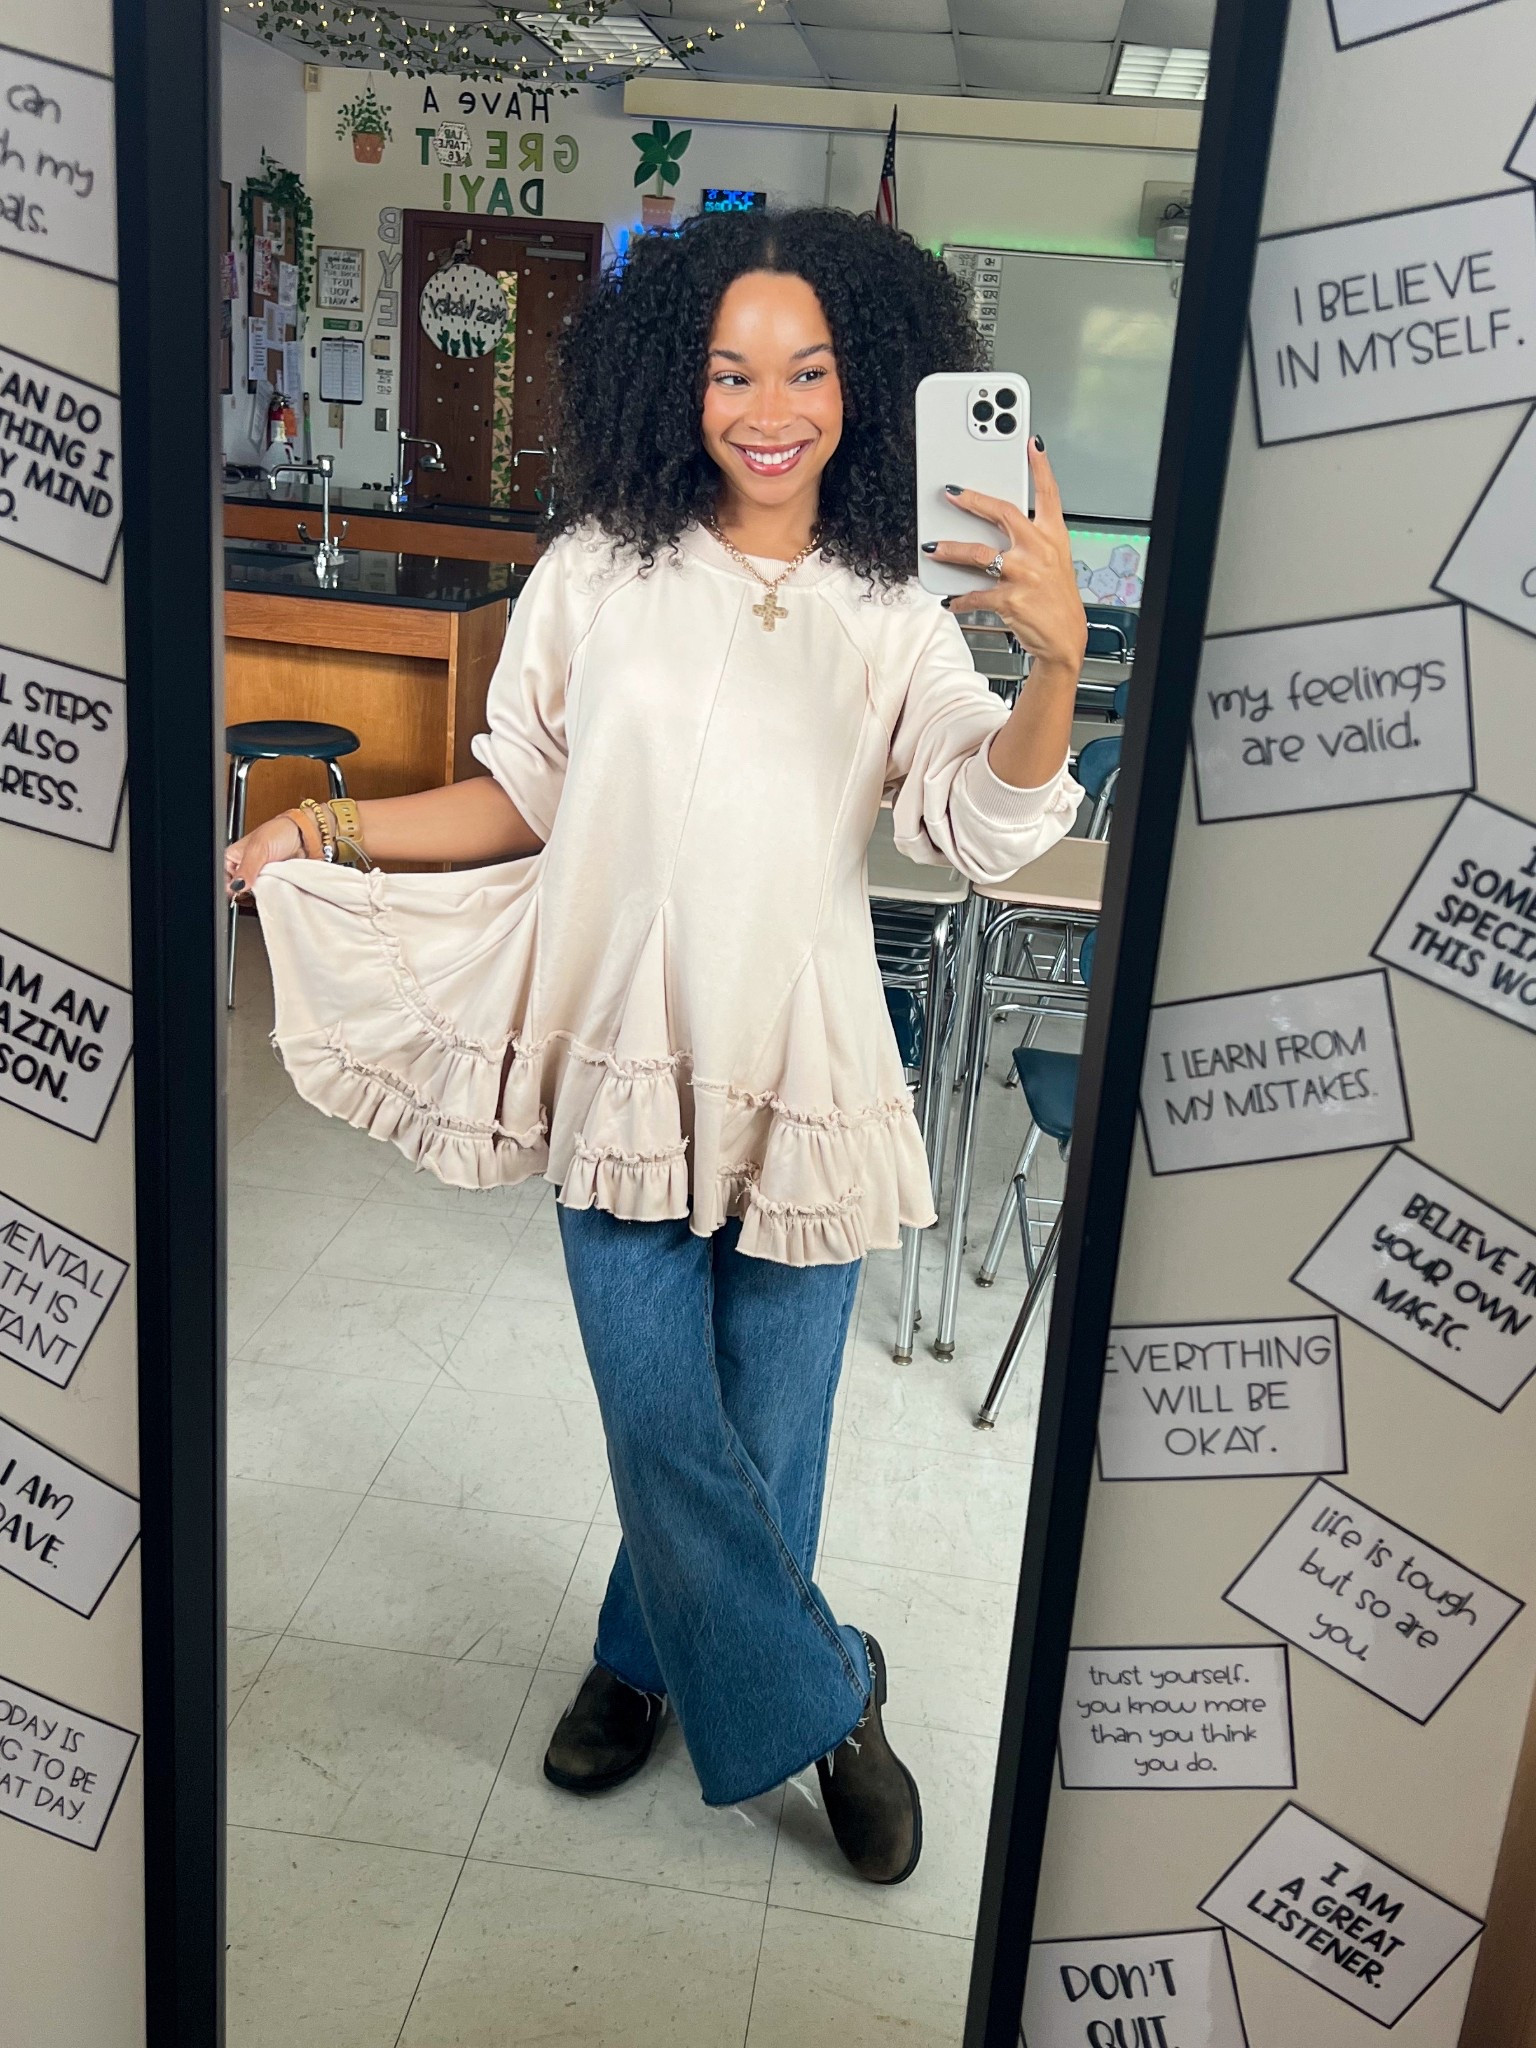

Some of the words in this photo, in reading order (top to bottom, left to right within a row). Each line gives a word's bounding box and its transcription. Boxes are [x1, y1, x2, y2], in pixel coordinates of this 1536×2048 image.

[7, 84, 62, 124] can
[36, 151, 95, 198] my
[1294, 286, 1303, 326] I
[1318, 250, 1496, 323] BELIEVE
[1277, 340, 1319, 389] IN
[1338, 308, 1525, 378] MYSELF.
[0, 372, 50, 414] AN
[55, 392, 102, 434] DO
[23, 460, 114, 518] MIND
[92, 448, 115, 481] I
[25, 681, 113, 732] STEPS
[1208, 685, 1274, 722] my
[1287, 660, 1446, 711] feelings
[1, 721, 80, 764] ALSO
[1242, 734, 1305, 766] are
[1317, 709, 1421, 758] valid.
[0, 764, 82, 813] RESS.
[1409, 922, 1486, 977] THIS
[0, 955, 43, 1004] M
[51, 988, 110, 1034] AN
[1160, 1051, 1177, 1082] I
[1182, 1039, 1268, 1079] LEARN
[1275, 1026, 1367, 1065] FROM
[1164, 1089, 1214, 1126] MY
[1223, 1068, 1379, 1118] MISTAKES.
[1402, 1192, 1520, 1276] BELIEVE
[1, 1261, 43, 1305] TH
[45, 1290, 78, 1324] IS
[1372, 1277, 1470, 1352] MAGIC.
[1453, 1280, 1533, 1336] OWN
[1104, 1335, 1332, 1374] EVERYTHING
[1142, 1385, 1234, 1415] WILL
[1248, 1381, 1290, 1412] BE
[1165, 1425, 1277, 1456] OKAY.
[0, 1458, 17, 1486] I
[1311, 1506, 1362, 1548] life
[1365, 1538, 1393, 1568] is
[1397, 1556, 1477, 1625] tough
[1299, 1547, 1354, 1597] but
[1355, 1589, 1391, 1619] so
[1395, 1613, 1439, 1648] are
[1089, 1665, 1143, 1686] trust
[1150, 1664, 1250, 1689] yourself.
[1077, 1700, 1121, 1718] you
[1128, 1696, 1197, 1714] know
[1204, 1698, 1266, 1713] more
[60, 1727, 85, 1752] IS
[1091, 1724, 1142, 1744] than
[1149, 1730, 1194, 1748] you
[1202, 1723, 1257, 1743] think
[32, 1749, 65, 1780] TO
[70, 1766, 98, 1794] BE
[1135, 1758, 1179, 1776] you
[1186, 1751, 1217, 1772] do.
[34, 1786, 86, 1825] DAY.
[1279, 1876, 1305, 1901] A
[1312, 1895, 1405, 1958] GREAT
[1320, 1862, 1349, 1888] I
[1345, 1882, 1405, 1924] AM
[1247, 1889, 1385, 1989] LISTENER.
